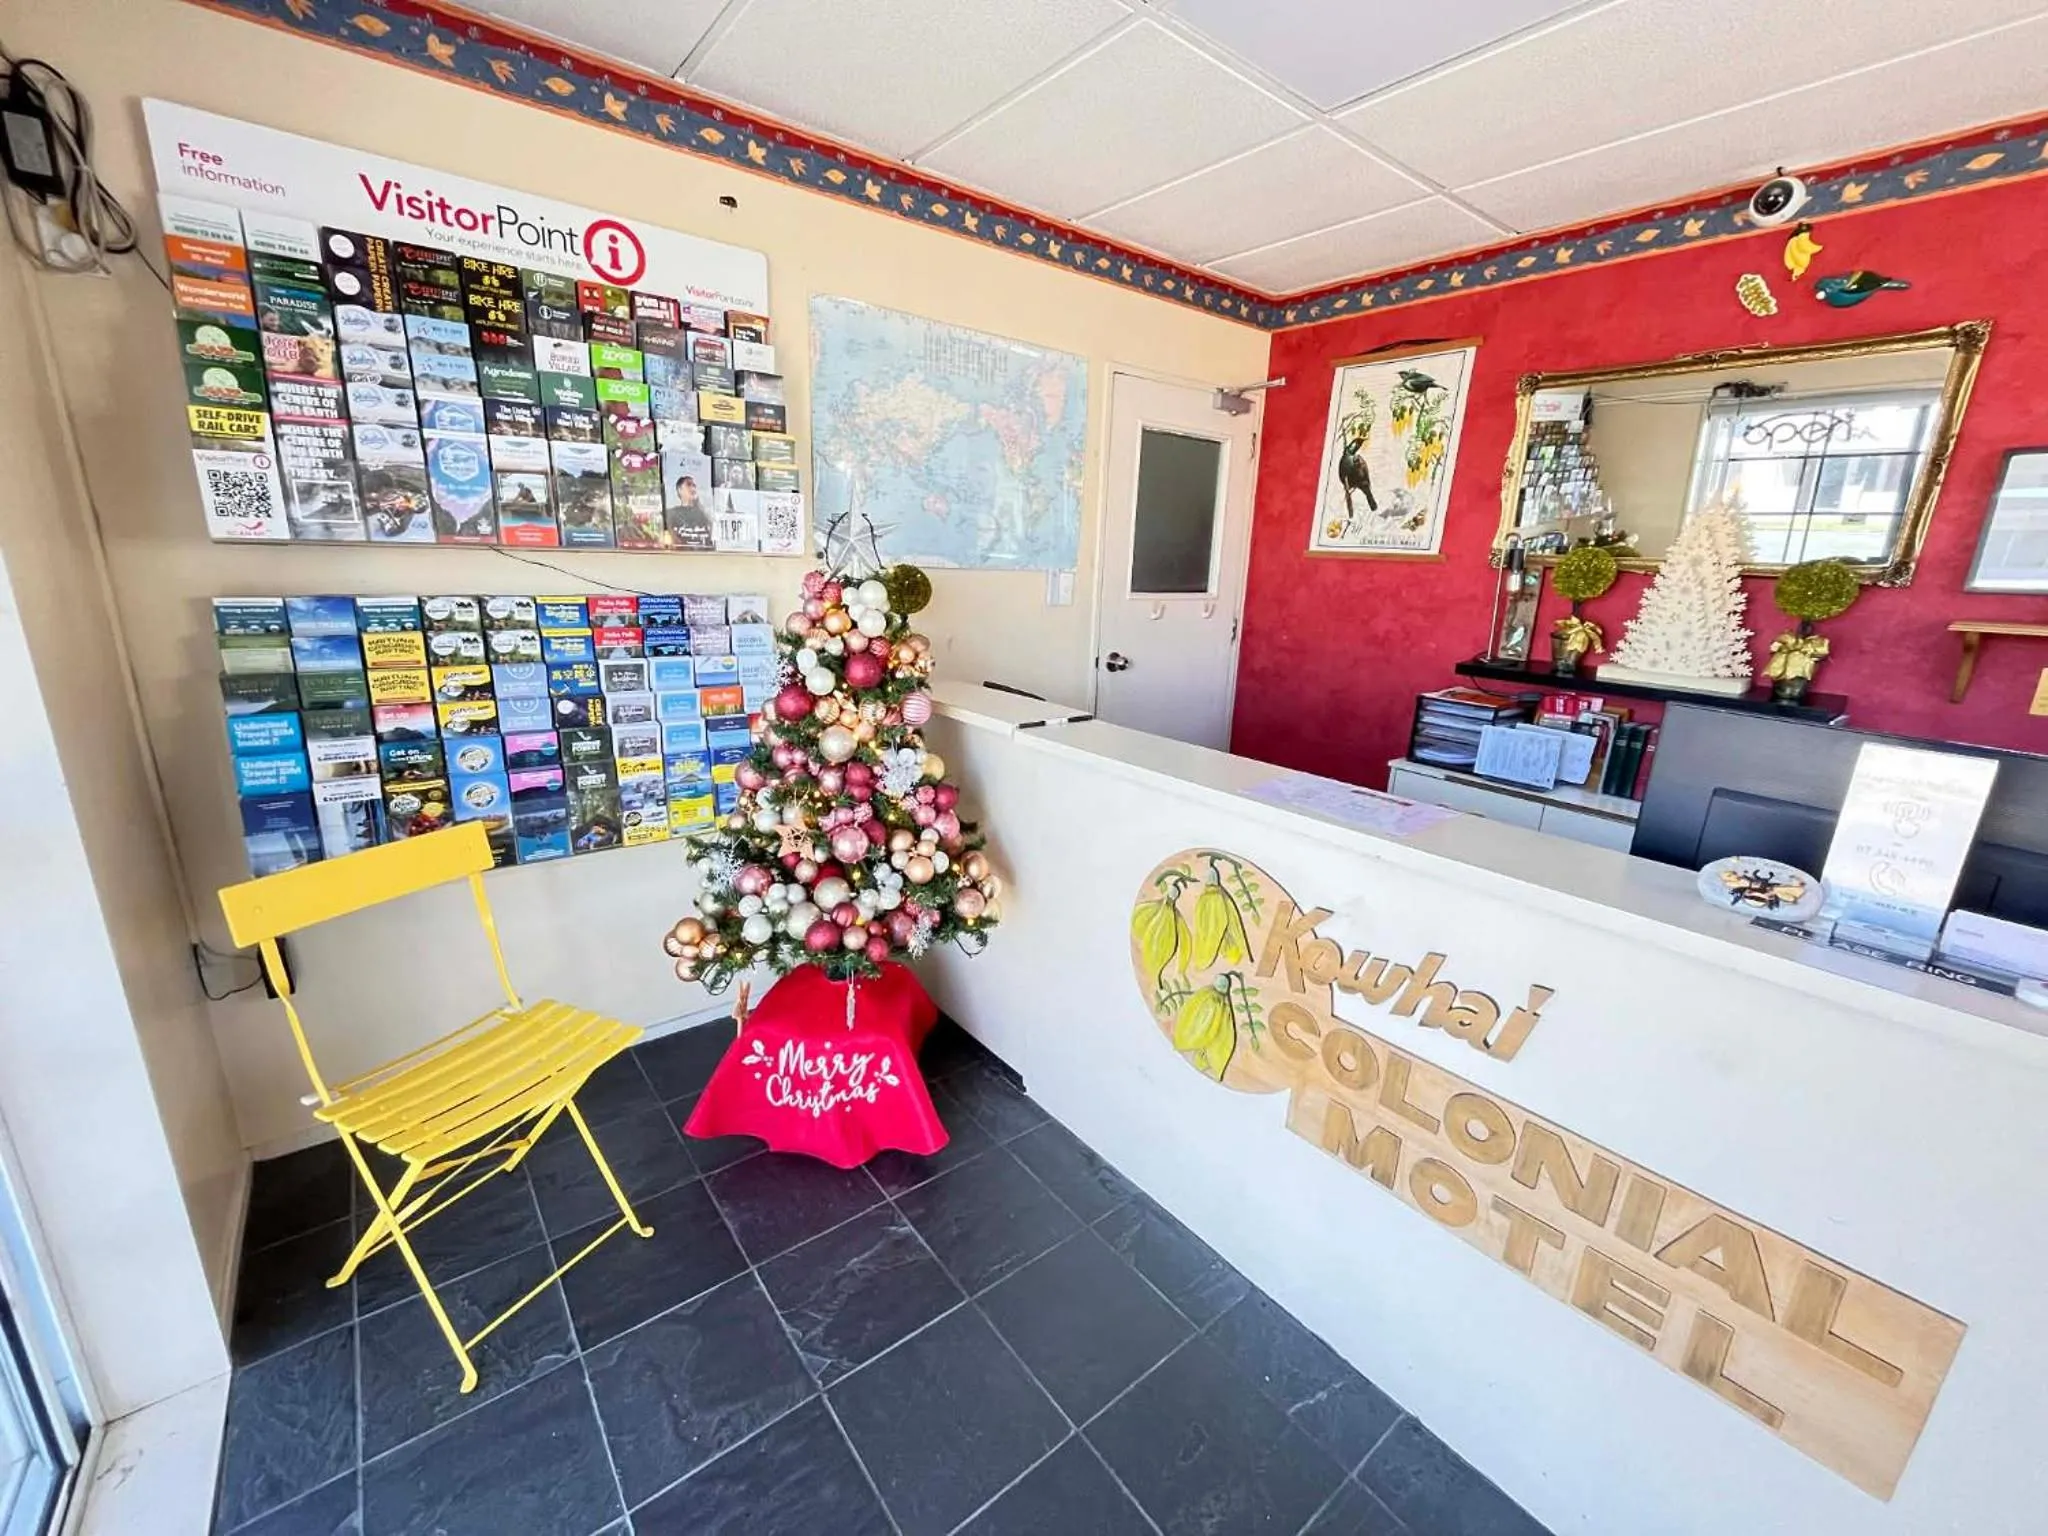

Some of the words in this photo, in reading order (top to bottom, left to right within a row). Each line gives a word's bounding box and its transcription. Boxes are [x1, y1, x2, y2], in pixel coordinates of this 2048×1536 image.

[178, 142, 223, 166] Free
[181, 160, 286, 197] information
[425, 226, 456, 243] Your
[457, 236, 524, 260] experience
[525, 250, 556, 266] starts
[463, 257, 490, 273] BIKE
[492, 264, 517, 279] HIRE
[269, 295, 319, 311] PARADISE
[468, 293, 496, 308] BIKE
[498, 299, 521, 313] HIRE
[483, 365, 533, 379] Agrodome
[275, 382, 316, 396] WHERE
[195, 408, 262, 425] SELF-DRIVE
[198, 420, 225, 432] RAIL
[229, 423, 258, 434] CARS
[280, 424, 322, 437] WHERE
[1255, 899, 1556, 1064] Kowhai
[1905, 960, 1977, 985] RING
[778, 1038, 876, 1087] Merry
[765, 1074, 880, 1119] Christmas
[1268, 1001, 1905, 1389] COLONIAL
[1321, 1097, 1785, 1430] MOTEL
